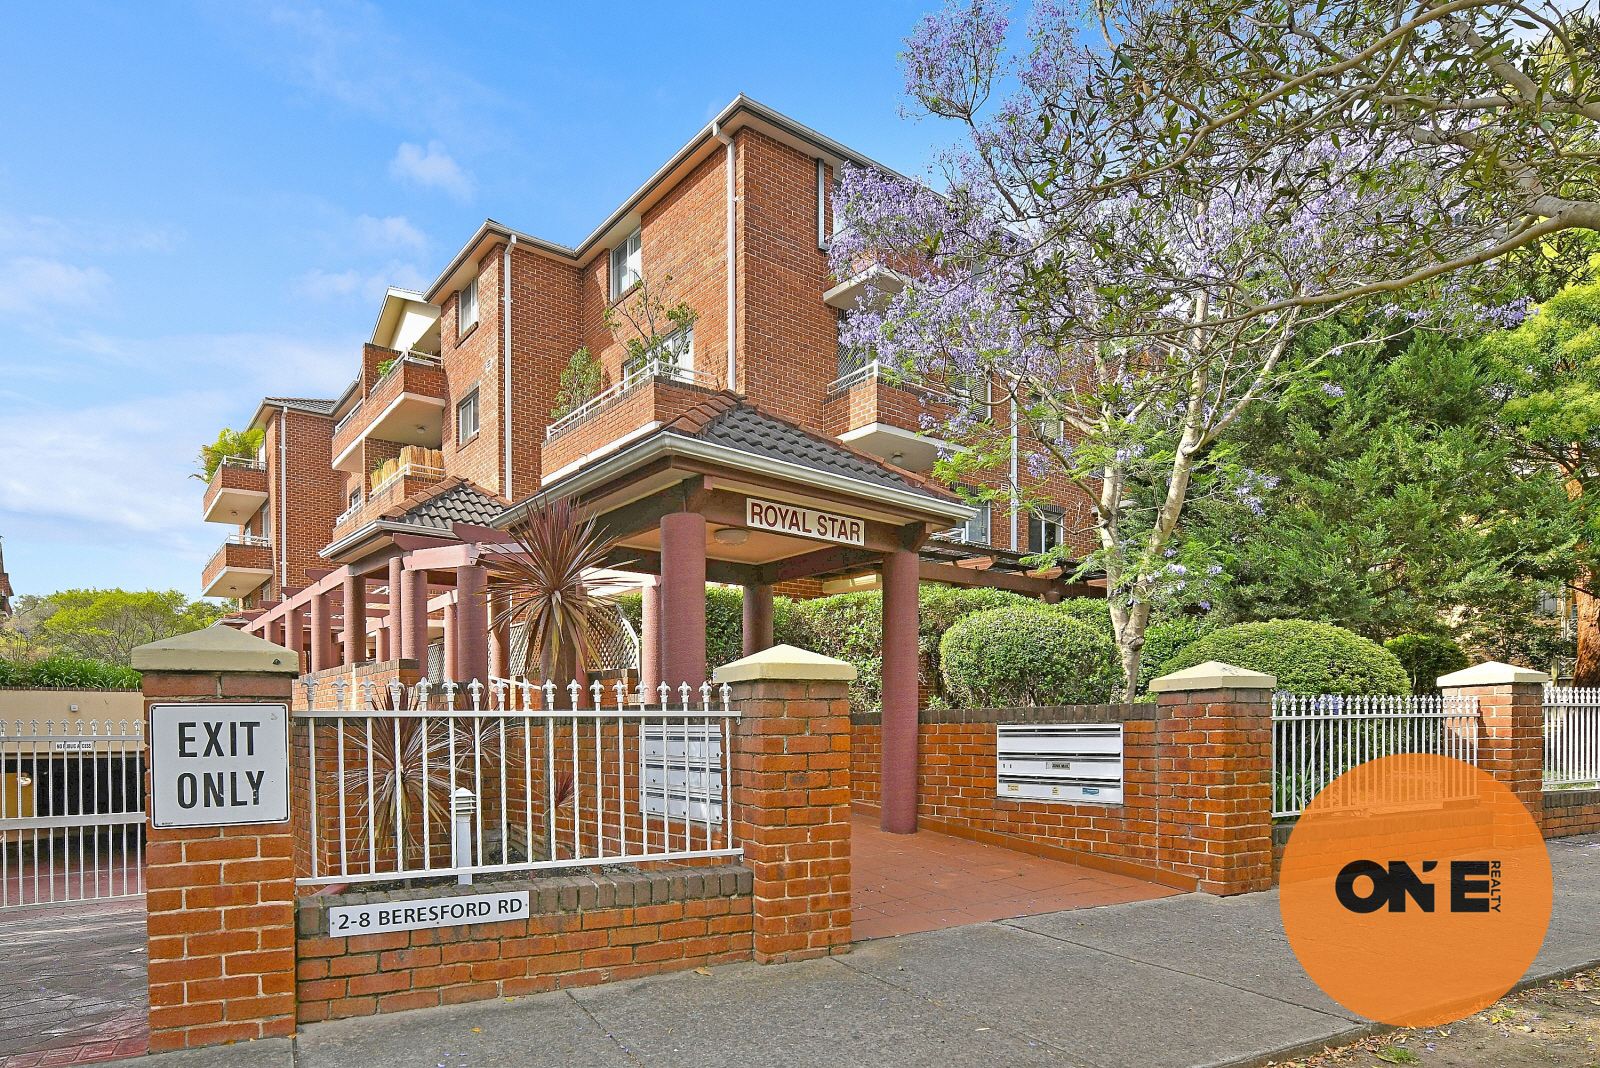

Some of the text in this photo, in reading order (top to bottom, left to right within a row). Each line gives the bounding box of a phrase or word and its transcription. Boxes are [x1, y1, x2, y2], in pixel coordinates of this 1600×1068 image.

[750, 502, 860, 542] ROYAL STAR
[178, 721, 261, 757] EXIT
[177, 771, 265, 809] ONLY
[338, 898, 522, 930] 2-8 BERESFORD RD
